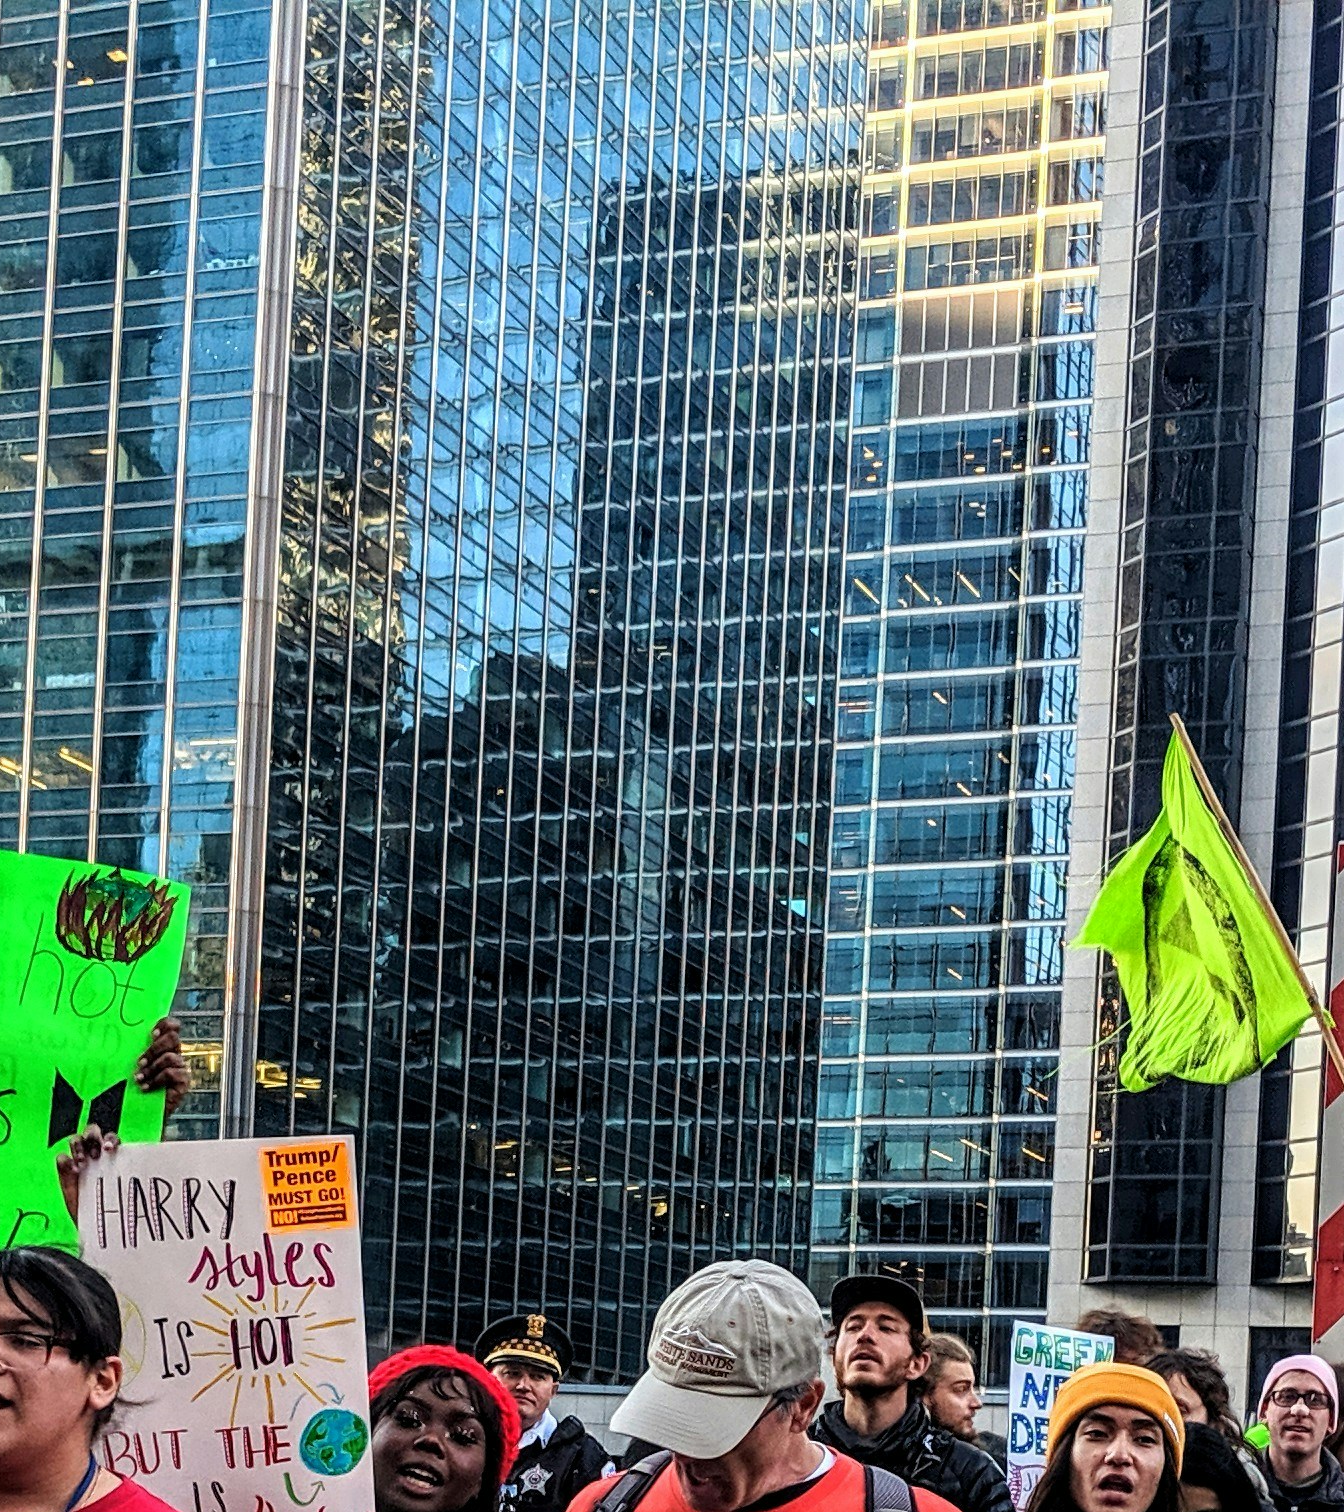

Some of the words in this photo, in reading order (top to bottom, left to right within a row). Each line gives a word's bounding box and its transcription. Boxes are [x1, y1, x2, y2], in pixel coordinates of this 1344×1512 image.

[18, 912, 146, 1028] hot
[264, 1145, 339, 1167] Trump/
[273, 1169, 336, 1187] Pence
[268, 1190, 313, 1206] MUST
[318, 1187, 345, 1202] GO!
[97, 1176, 236, 1250] HARRY
[273, 1210, 298, 1225] NO!
[155, 1317, 194, 1379] IS
[230, 1314, 299, 1371] HOT
[689, 1351, 735, 1370] SANDS
[1010, 1413, 1050, 1455] DE
[103, 1428, 188, 1479] BUT
[216, 1425, 292, 1470] THE
